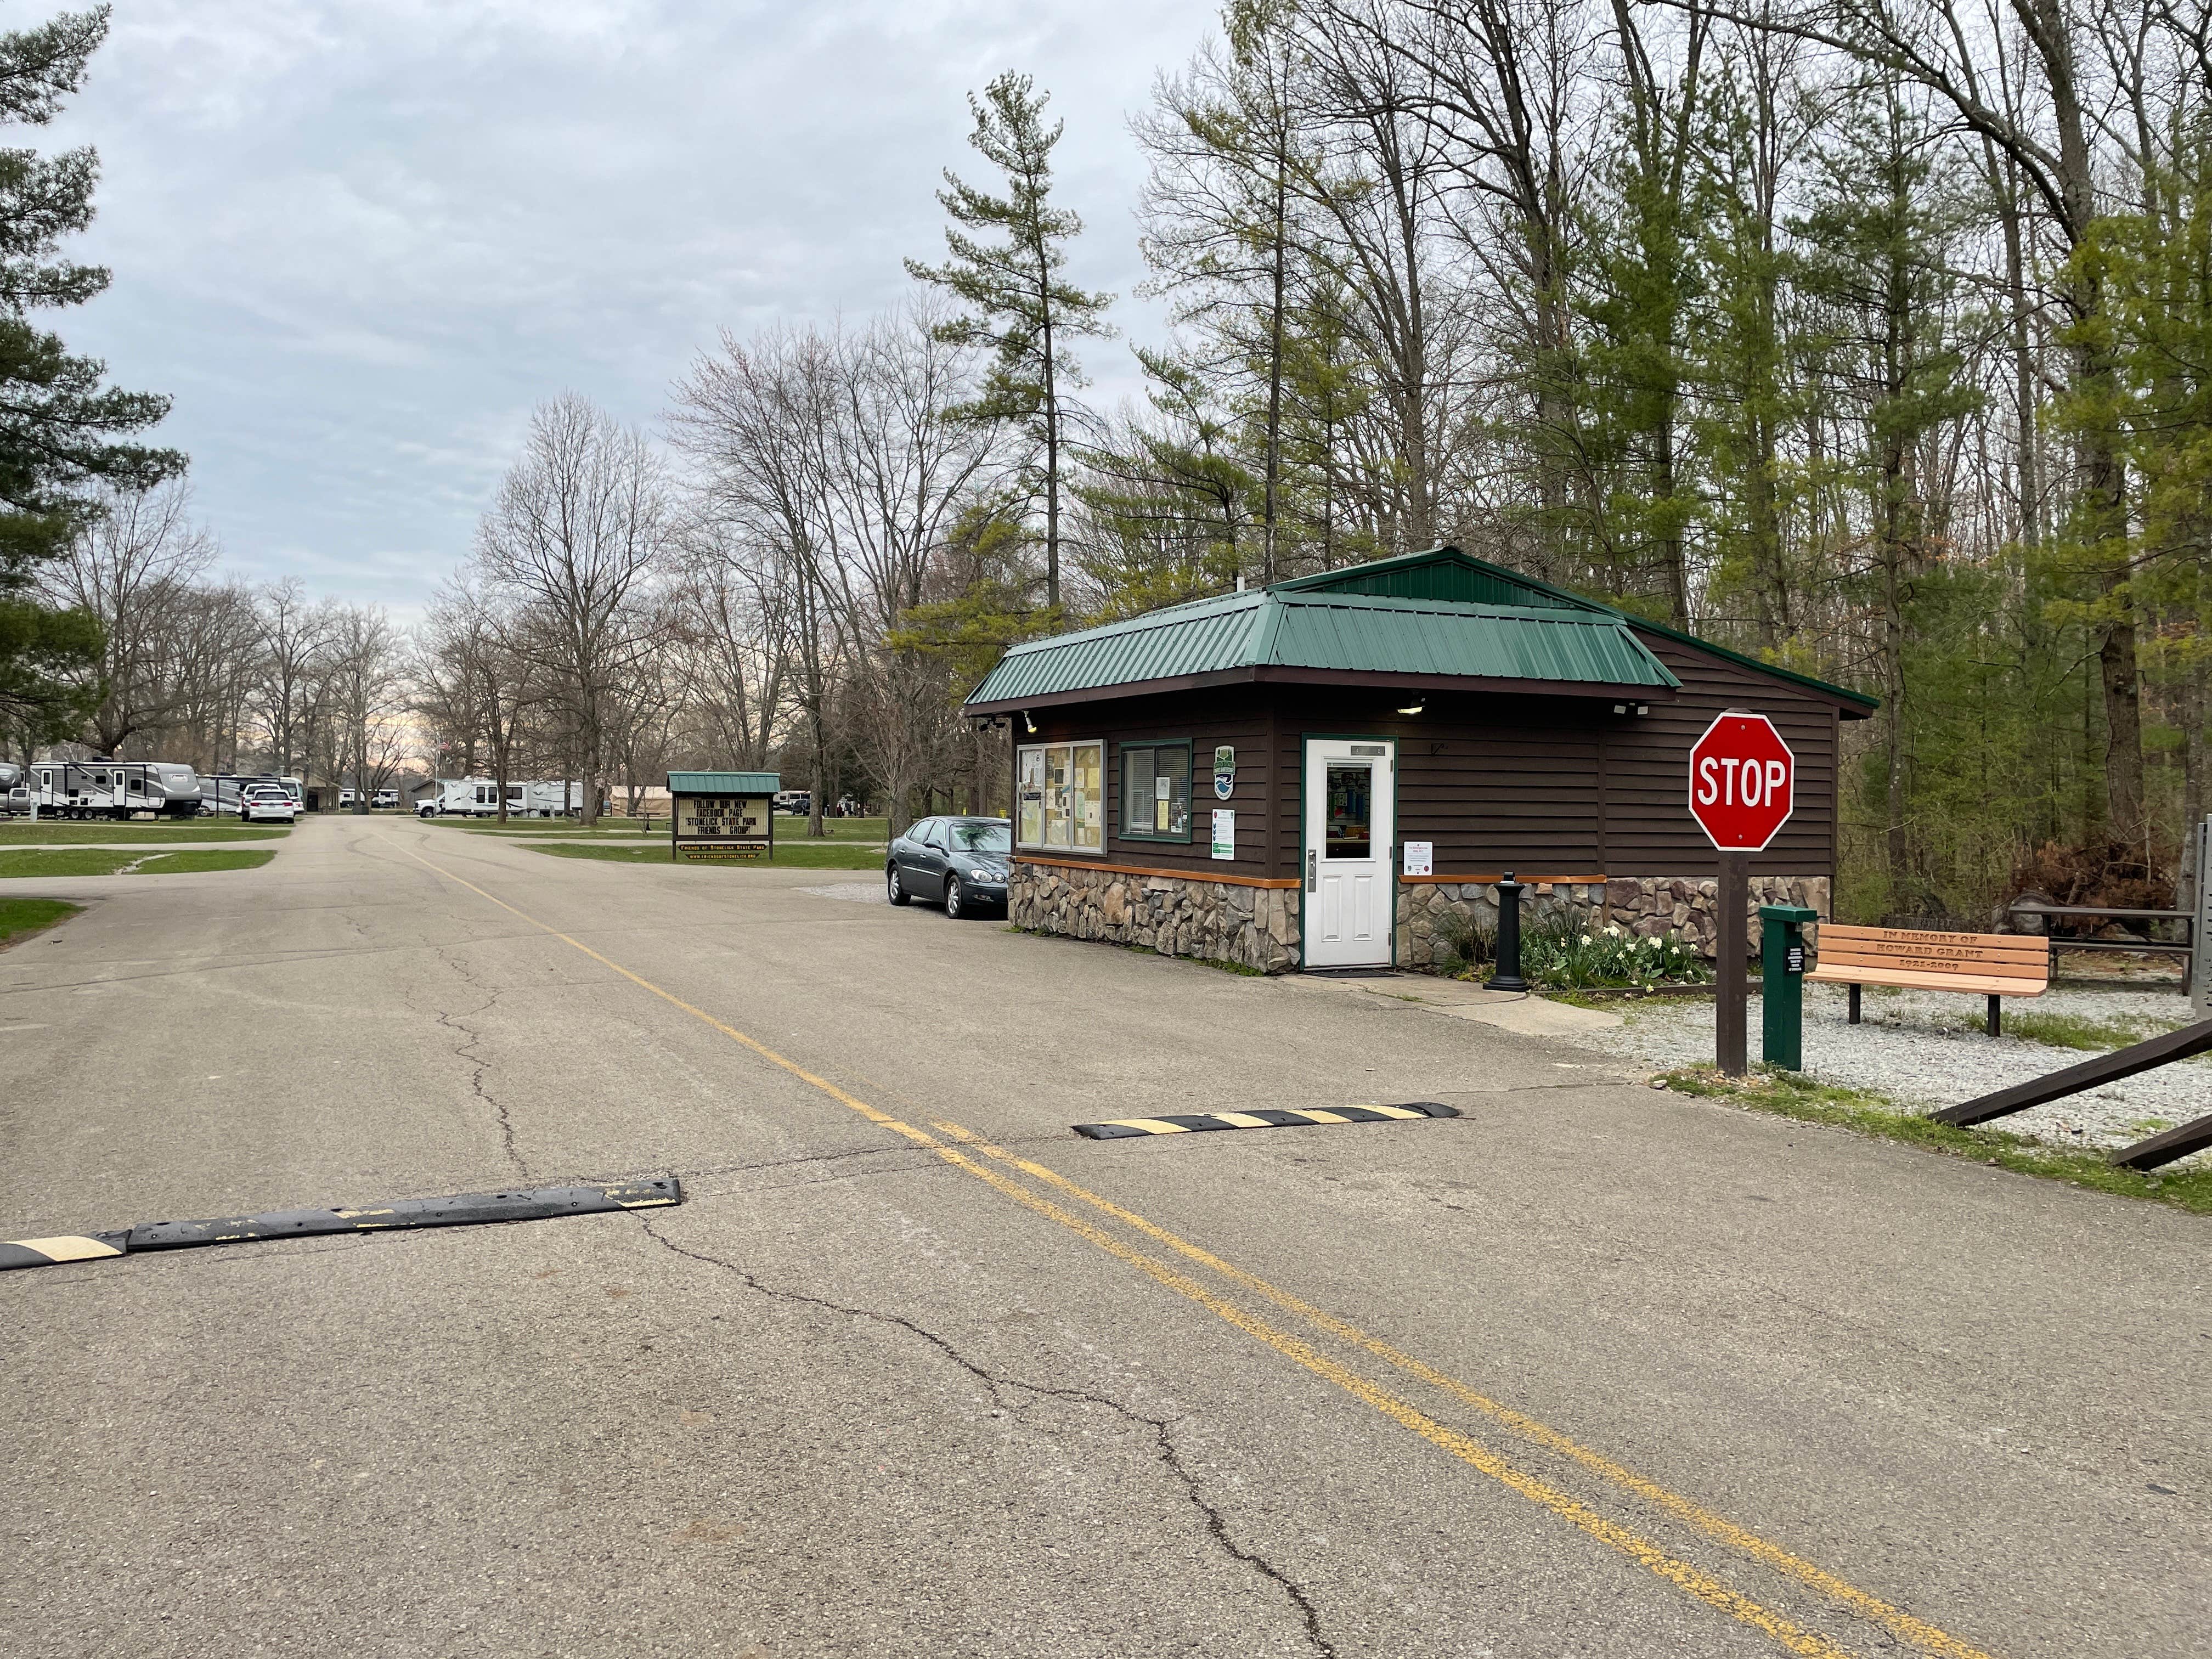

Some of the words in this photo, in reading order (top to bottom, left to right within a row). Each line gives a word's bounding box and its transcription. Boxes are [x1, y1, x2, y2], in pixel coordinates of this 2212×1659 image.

[1697, 757, 1786, 807] STOP
[693, 800, 715, 809] FOLLOW
[719, 800, 730, 809] OUR
[735, 800, 747, 809] NEW
[696, 809, 724, 817] FACEBOOK
[1901, 932, 1957, 943] MEMORY
[1960, 936, 1978, 944] OF
[1876, 944, 1932, 955] HOWARD
[1937, 948, 1984, 958] GRANT
[1899, 960, 1959, 970] 1921-2009
